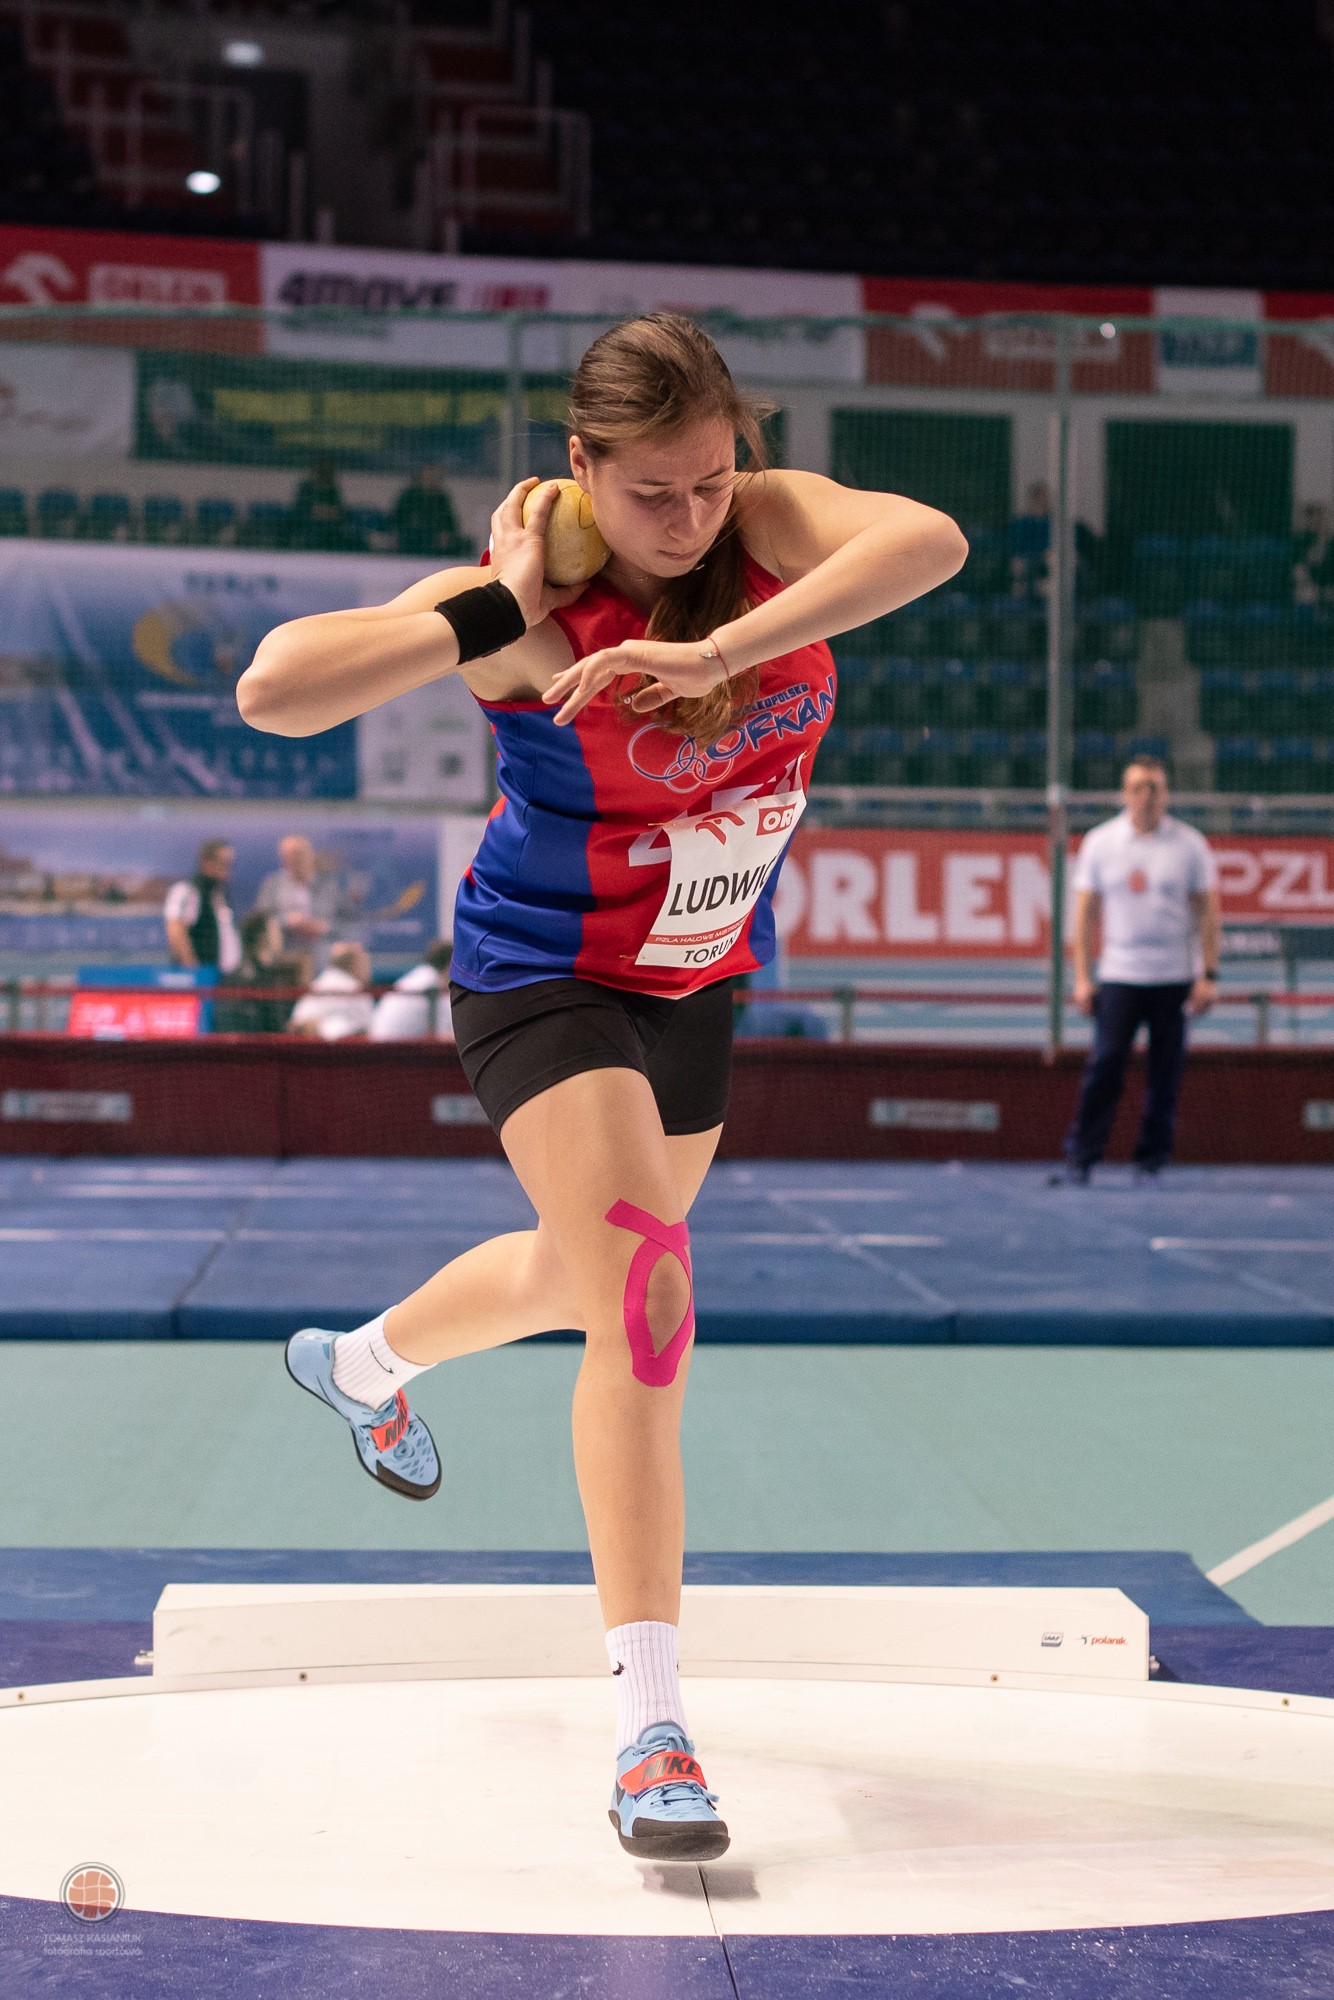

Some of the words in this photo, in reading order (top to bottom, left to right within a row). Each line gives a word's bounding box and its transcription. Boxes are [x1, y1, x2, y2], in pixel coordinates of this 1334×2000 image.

[706, 674, 834, 761] ORKAN
[680, 934, 714, 943] HALOWE
[641, 1757, 699, 1784] NIKE
